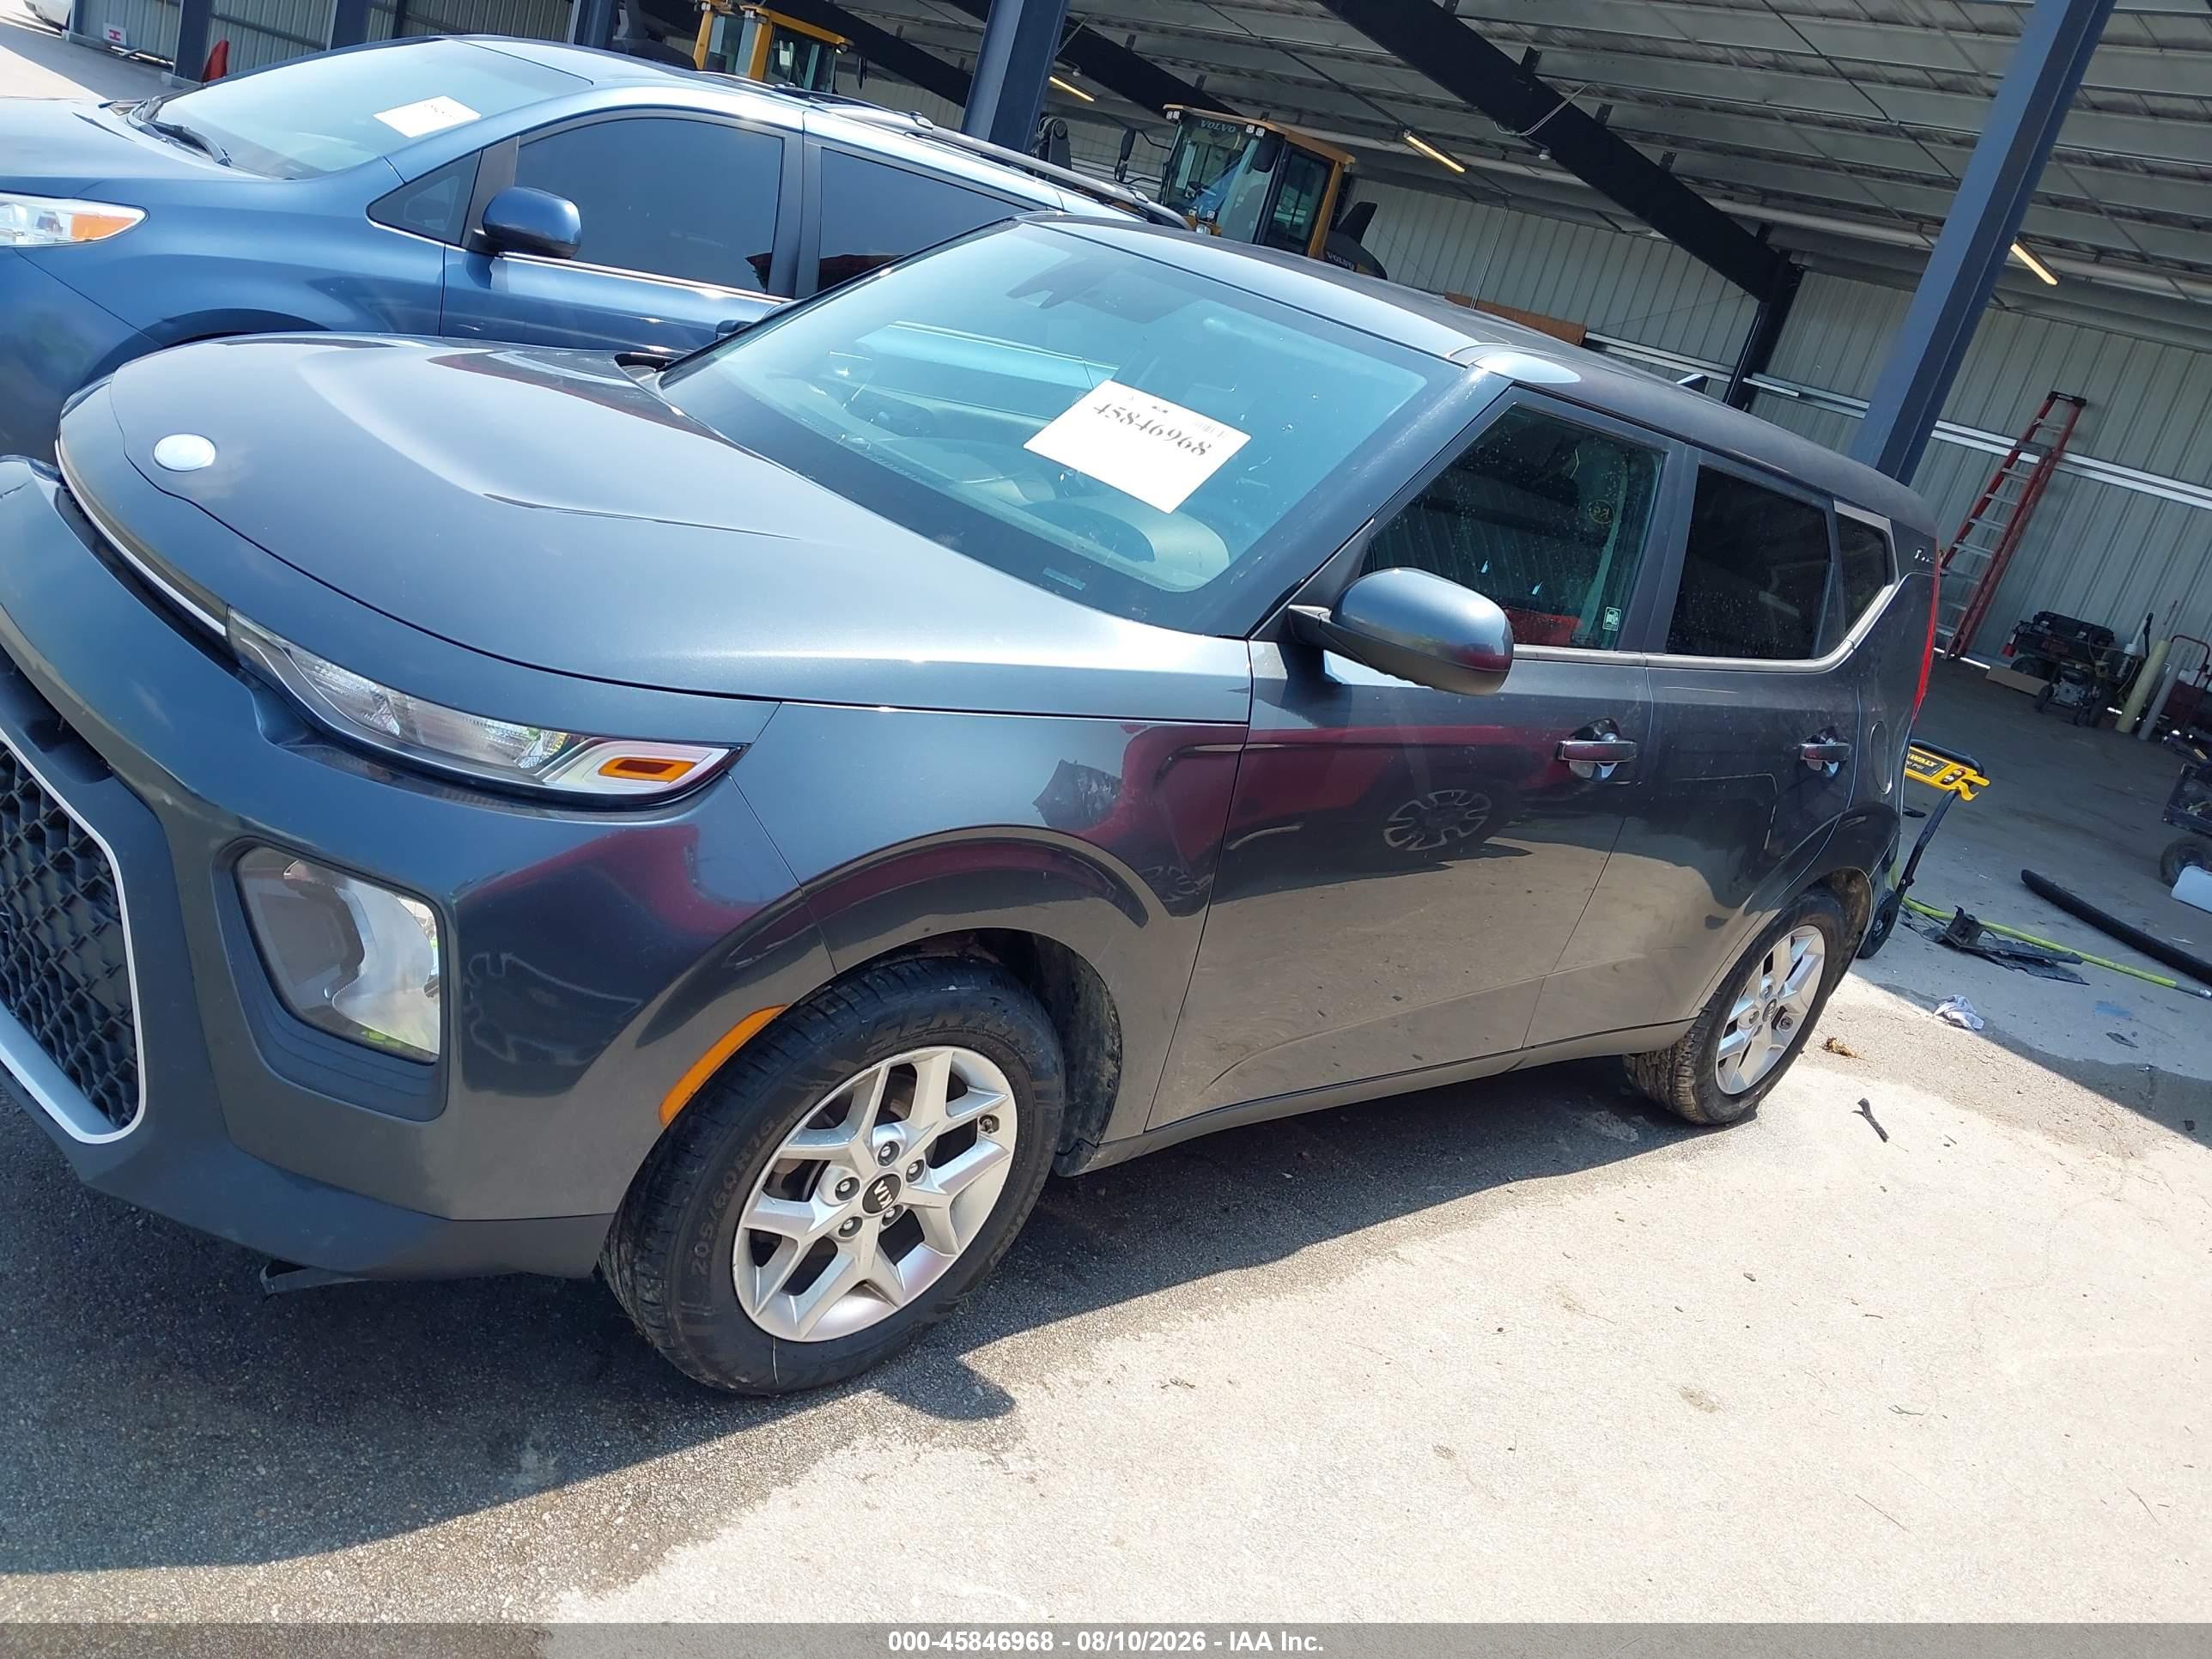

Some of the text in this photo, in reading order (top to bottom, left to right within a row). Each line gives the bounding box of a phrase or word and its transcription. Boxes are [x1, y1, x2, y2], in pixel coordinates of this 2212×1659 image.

[1201, 119, 1237, 133] VOLVO
[1092, 403, 1212, 456] 45846968
[1908, 753, 1938, 767] WALT
[873, 1179, 893, 1209] KIA
